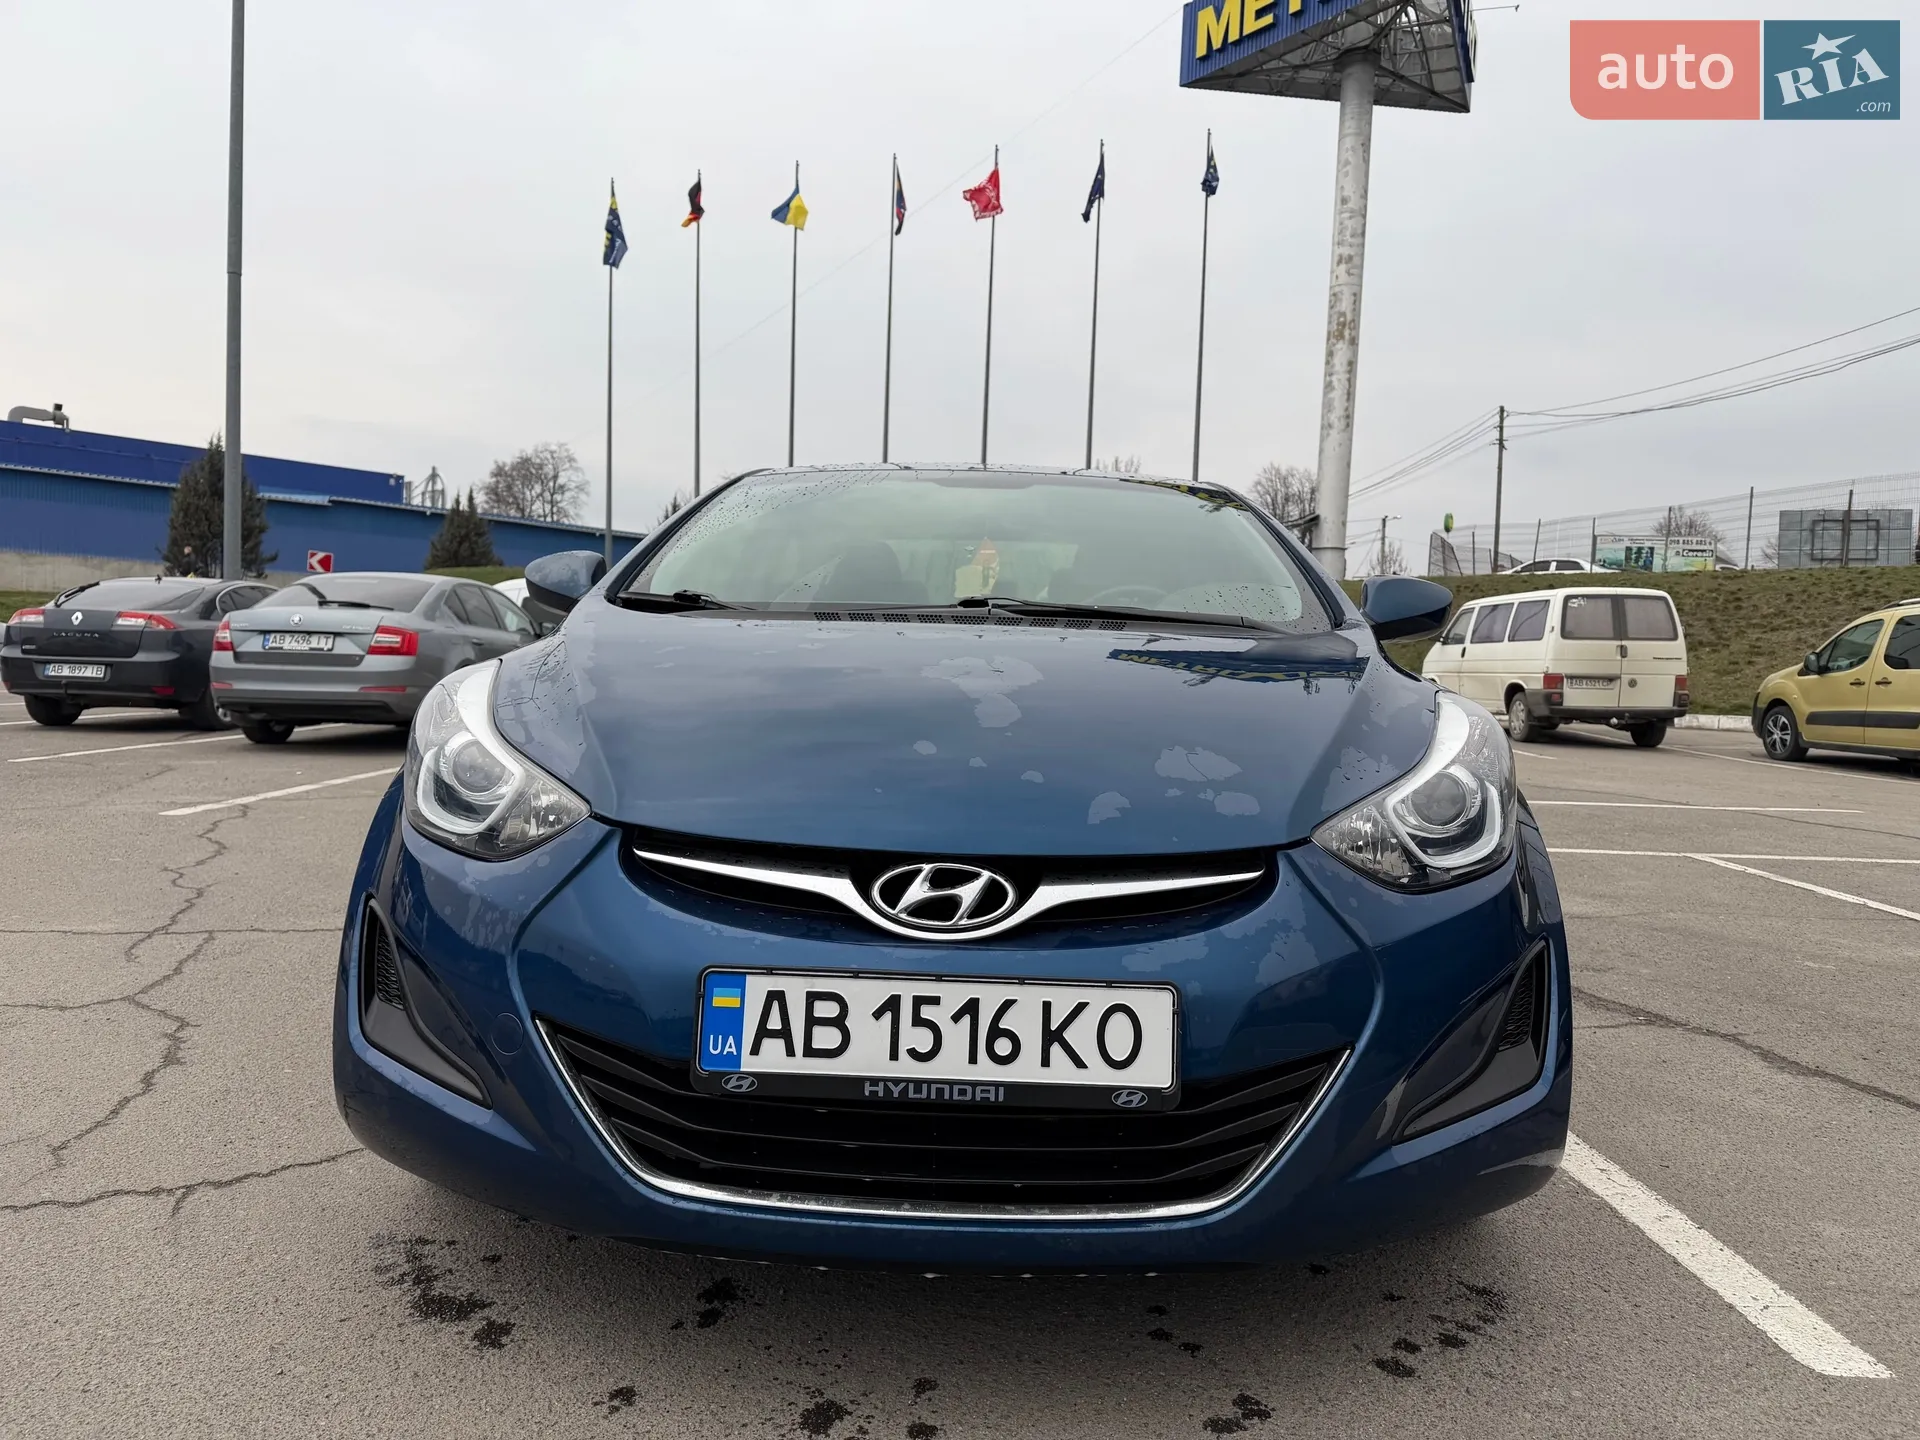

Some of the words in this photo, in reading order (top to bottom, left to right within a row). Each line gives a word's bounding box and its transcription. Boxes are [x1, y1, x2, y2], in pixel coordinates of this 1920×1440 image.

[270, 633, 286, 645] AB
[288, 633, 312, 645] 7496
[50, 664, 63, 674] AB
[67, 665, 89, 675] 1897
[748, 989, 852, 1060] AB
[871, 993, 1023, 1067] 1516
[1040, 1000, 1143, 1070] KO
[708, 1034, 738, 1057] UA
[864, 1080, 1005, 1102] HYUNDAI
